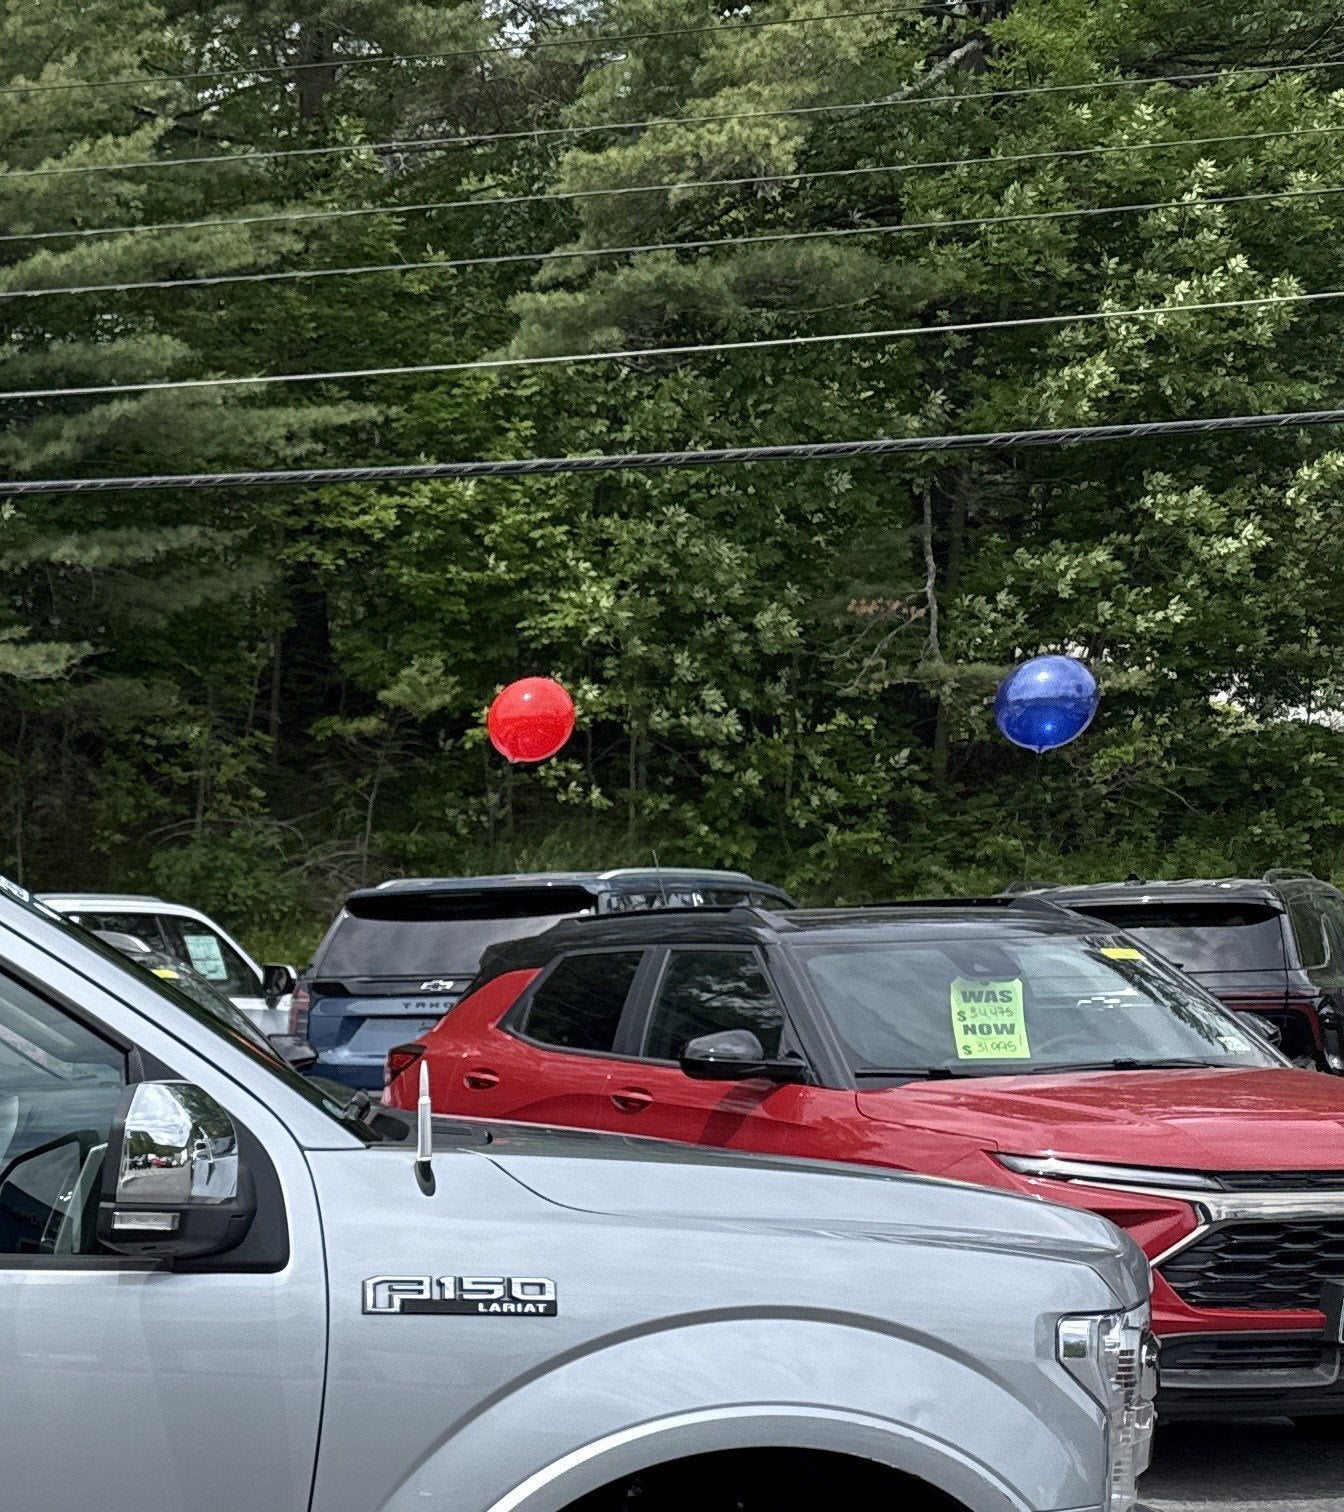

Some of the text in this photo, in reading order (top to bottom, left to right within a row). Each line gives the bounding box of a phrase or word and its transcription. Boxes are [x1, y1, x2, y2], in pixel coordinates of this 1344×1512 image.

[961, 990, 1013, 1003] WAS
[962, 1023, 1016, 1036] NOW
[477, 1302, 548, 1314] LARIAT
